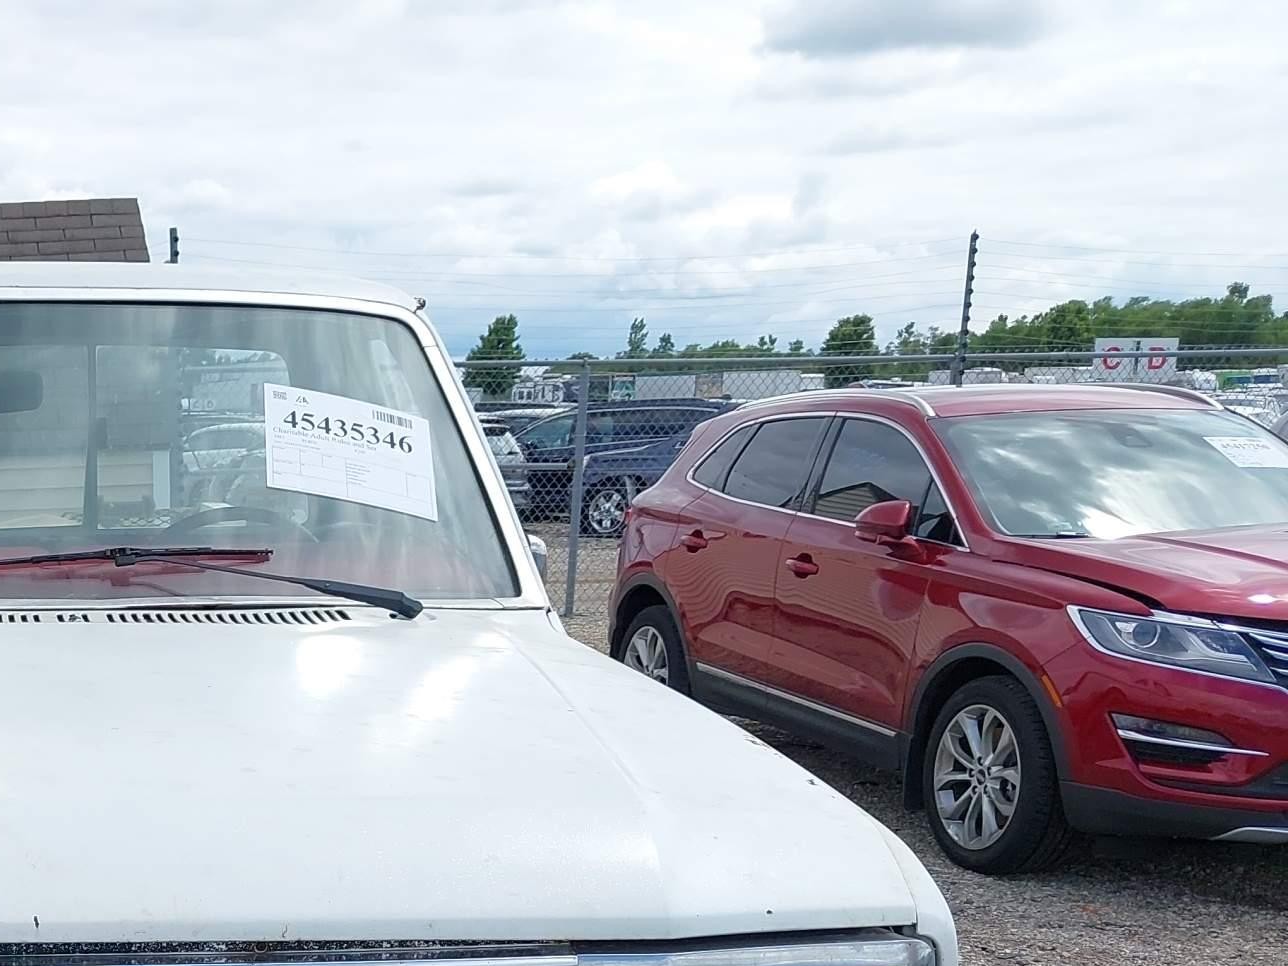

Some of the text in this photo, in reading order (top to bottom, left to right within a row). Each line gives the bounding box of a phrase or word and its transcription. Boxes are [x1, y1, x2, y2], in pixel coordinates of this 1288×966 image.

[1102, 346, 1168, 370] C D
[283, 410, 413, 454] 45435346
